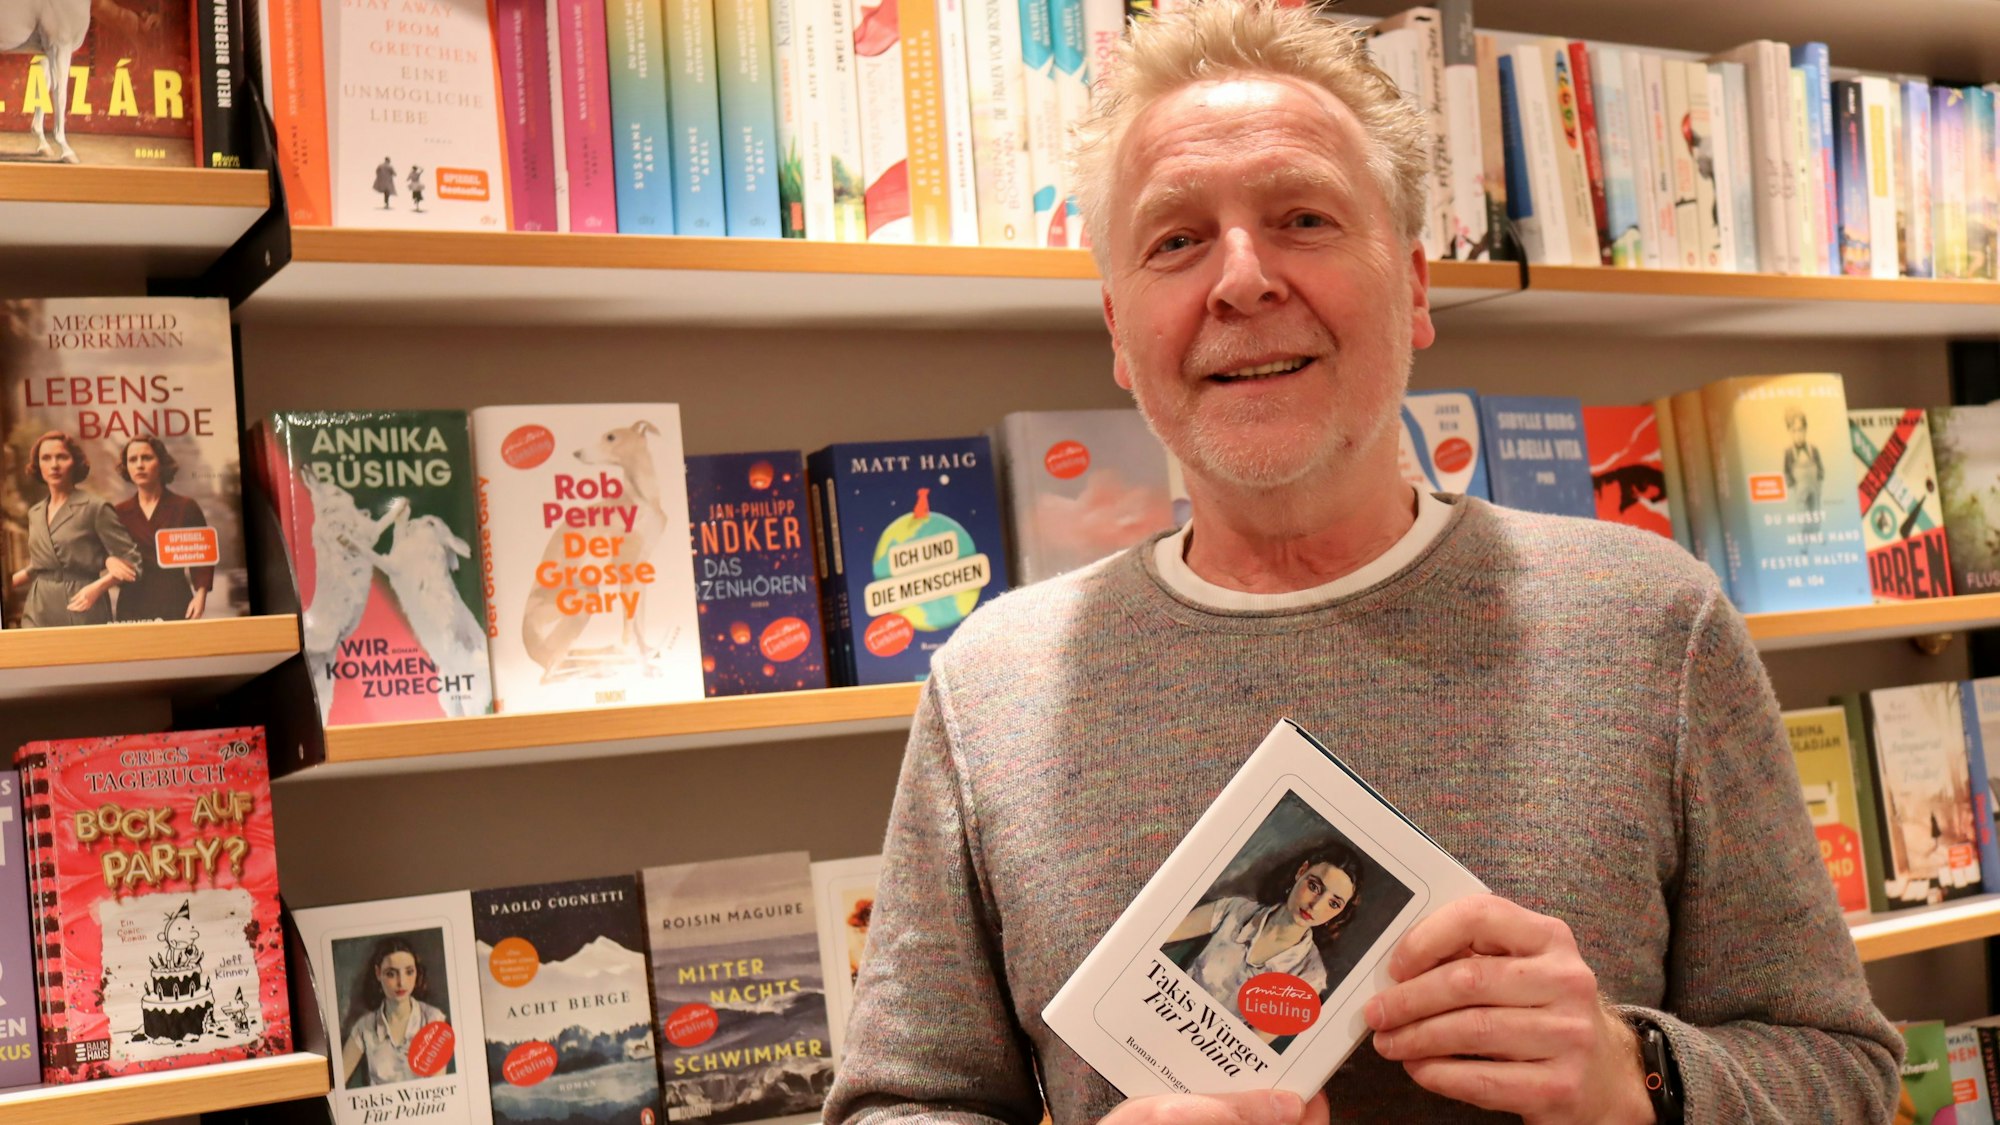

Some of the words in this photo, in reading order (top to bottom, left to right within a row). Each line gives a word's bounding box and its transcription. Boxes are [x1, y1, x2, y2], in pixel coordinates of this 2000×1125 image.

[401, 1, 454, 17] AWAY
[385, 20, 440, 38] FROM
[777, 0, 791, 48] Katze
[370, 40, 478, 63] GRETCHEN
[836, 39, 846, 73] ZWEI
[907, 36, 919, 80] BEER
[0, 55, 184, 120] ÁZÁR
[217, 68, 232, 108] NELIO
[401, 66, 449, 83] EINE
[343, 83, 483, 109] UNMÖGLICHE
[370, 108, 429, 125] LIEBE
[911, 88, 927, 187] ELISABETH
[134, 148, 166, 159] ROMAN
[631, 122, 645, 190] SUSANNE
[644, 136, 654, 173] ABEL
[688, 126, 701, 193] SUSANNE
[700, 140, 710, 176] ABEL
[743, 126, 756, 193] SUSANNE
[755, 139, 766, 175] ABEL
[930, 167, 942, 197] DIE
[52, 313, 177, 332] MECHTILD
[49, 332, 184, 350] BORRMANN
[25, 375, 184, 408] LEBENS-
[78, 408, 214, 440] BANDE
[1497, 412, 1542, 431] SIBYLLE
[1544, 413, 1576, 431] BERG
[312, 427, 448, 455] ANNIKA
[1498, 439, 1515, 460] LA
[1517, 438, 1554, 460] BELLA
[1555, 439, 1583, 461] VITA
[311, 454, 452, 488] BÜSING
[851, 457, 910, 474] MATT
[920, 452, 977, 471] HAIG
[478, 475, 490, 524] Gary
[554, 472, 624, 500] Rob
[543, 503, 638, 533] Perry
[708, 499, 796, 520] JAN-PHILIPP
[1764, 514, 1783, 526] DU
[1787, 511, 1827, 524] MUSST
[168, 532, 205, 544] SPIEGEL
[563, 532, 625, 558] Der
[1787, 532, 1825, 545] MEINE
[1828, 530, 1860, 542] HAND
[172, 552, 205, 562] Autorin
[481, 529, 495, 599] Grosse
[704, 557, 743, 578] DAS
[894, 550, 921, 569] ICH
[923, 539, 955, 563] UND
[1761, 555, 1809, 570] FESTER
[1869, 533, 1948, 598] IRREN
[535, 561, 656, 589] Grosse
[872, 588, 896, 608] DIE
[899, 563, 983, 600] MENSCHEN
[555, 588, 640, 620] Gary
[487, 602, 499, 638] Der
[341, 638, 389, 658] WIR
[326, 658, 436, 680] KOMMEN
[362, 674, 476, 699] ZURECHT
[120, 746, 189, 768] GREGS
[219, 741, 251, 763] 20
[84, 764, 226, 793] TAGEBUCH
[74, 803, 176, 845] BOCK
[191, 788, 254, 827] AUF
[102, 835, 249, 890] PARTY?
[490, 901, 542, 916] PAOLO
[548, 890, 625, 909] COGNETTI
[663, 912, 722, 931] ROISIN
[726, 902, 805, 923] MAGUIRE
[120, 919, 135, 928] Ein
[121, 933, 148, 944] Roman
[214, 966, 251, 981] Kinney
[219, 955, 243, 969] Jeff
[677, 958, 765, 985] MITTER
[506, 1001, 559, 1020] ACHT
[568, 990, 632, 1011] BERGE
[710, 978, 802, 1004] NACHTS
[1144, 958, 1197, 1014] Takis
[1199, 1004, 1269, 1075] Würger
[1245, 998, 1312, 1024] Liebling
[670, 1015, 715, 1041] Liebling
[1141, 989, 1175, 1025] Für
[1175, 1019, 1242, 1079] Polina
[86, 1040, 109, 1051] BAUM
[87, 1049, 110, 1061] HAUS
[418, 1029, 452, 1074] Liebling
[674, 1039, 823, 1075] SCHWIMMER
[1125, 1036, 1157, 1067] Roman
[508, 1052, 554, 1082] Liebling
[347, 1095, 393, 1112] Takis
[396, 1084, 458, 1105] Würger
[559, 1080, 597, 1092] ROMAN
[362, 1108, 392, 1125] Für
[395, 1101, 446, 1122] Polina
